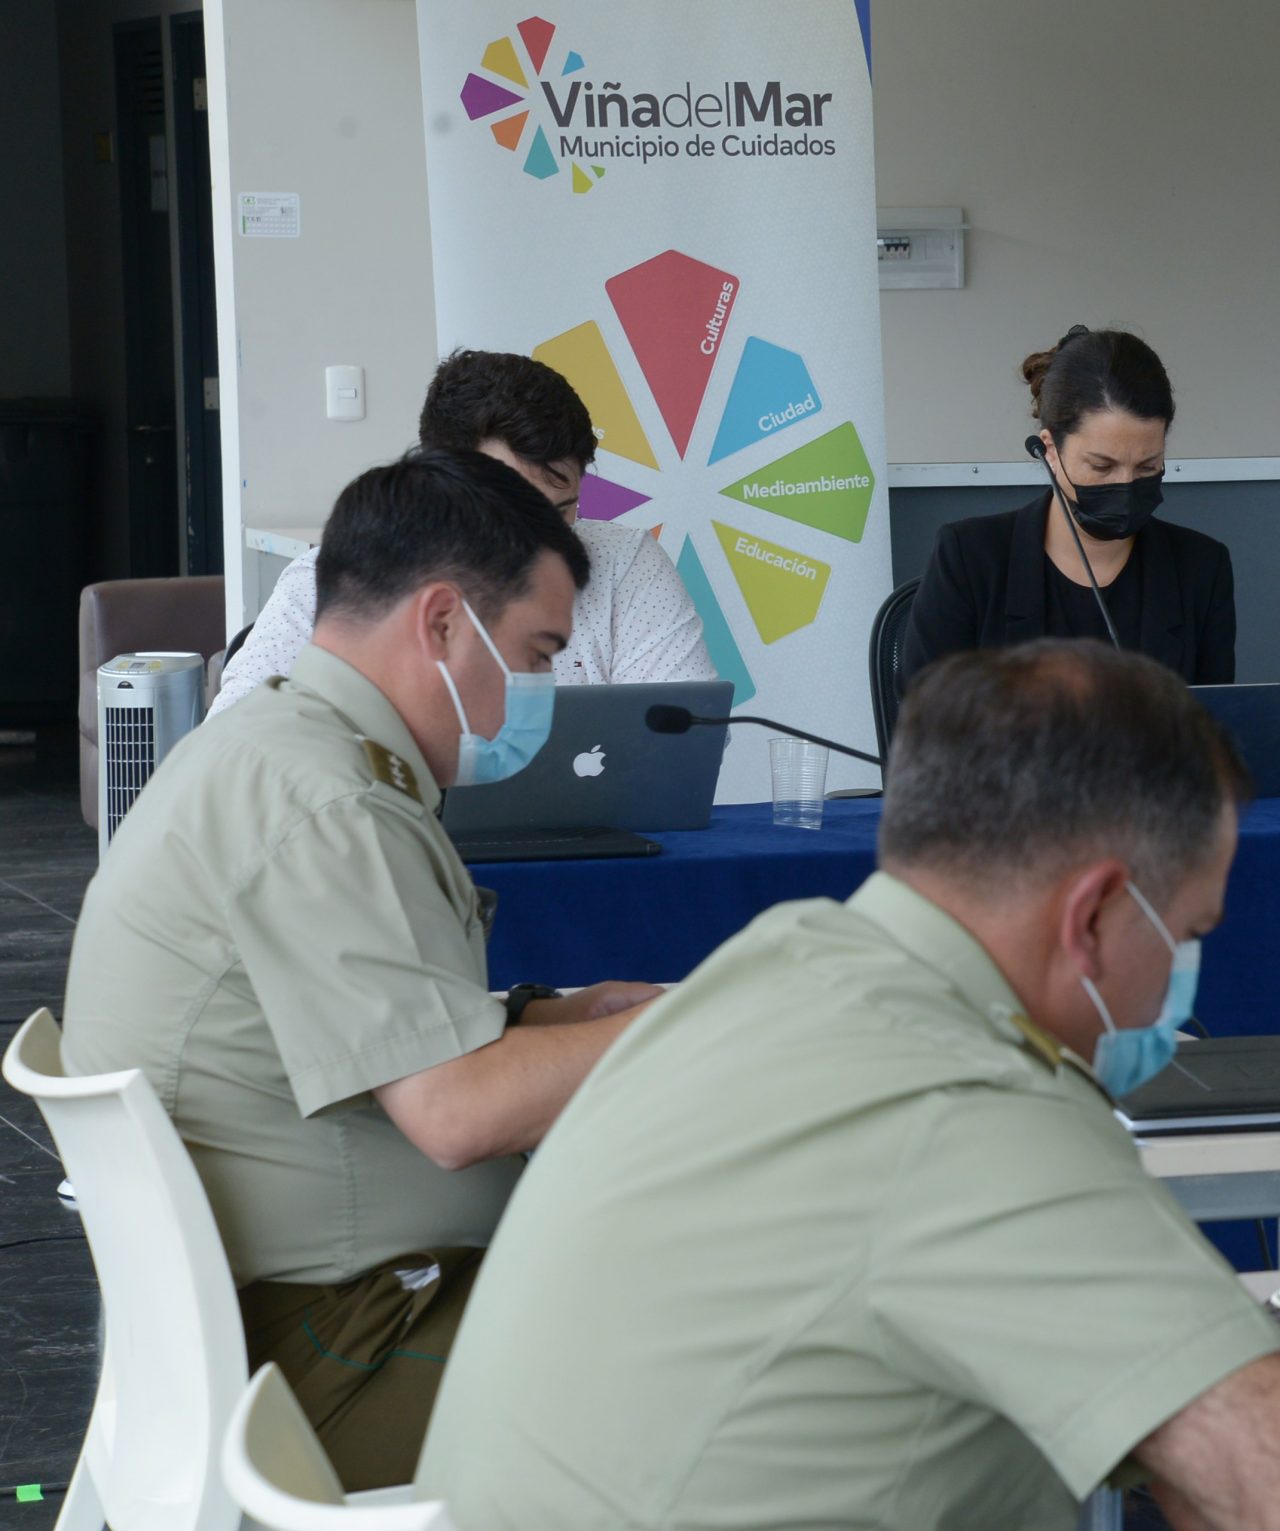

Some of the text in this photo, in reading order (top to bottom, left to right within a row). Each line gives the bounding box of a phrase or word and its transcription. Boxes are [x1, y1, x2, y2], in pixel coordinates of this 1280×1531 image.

[540, 81, 832, 128] ViñadelMar
[559, 133, 836, 164] Municipio de Cuidados
[700, 281, 734, 356] Culturas
[758, 393, 816, 432] Ciudad
[743, 473, 870, 500] Medioambiente
[734, 537, 818, 580] Educación
